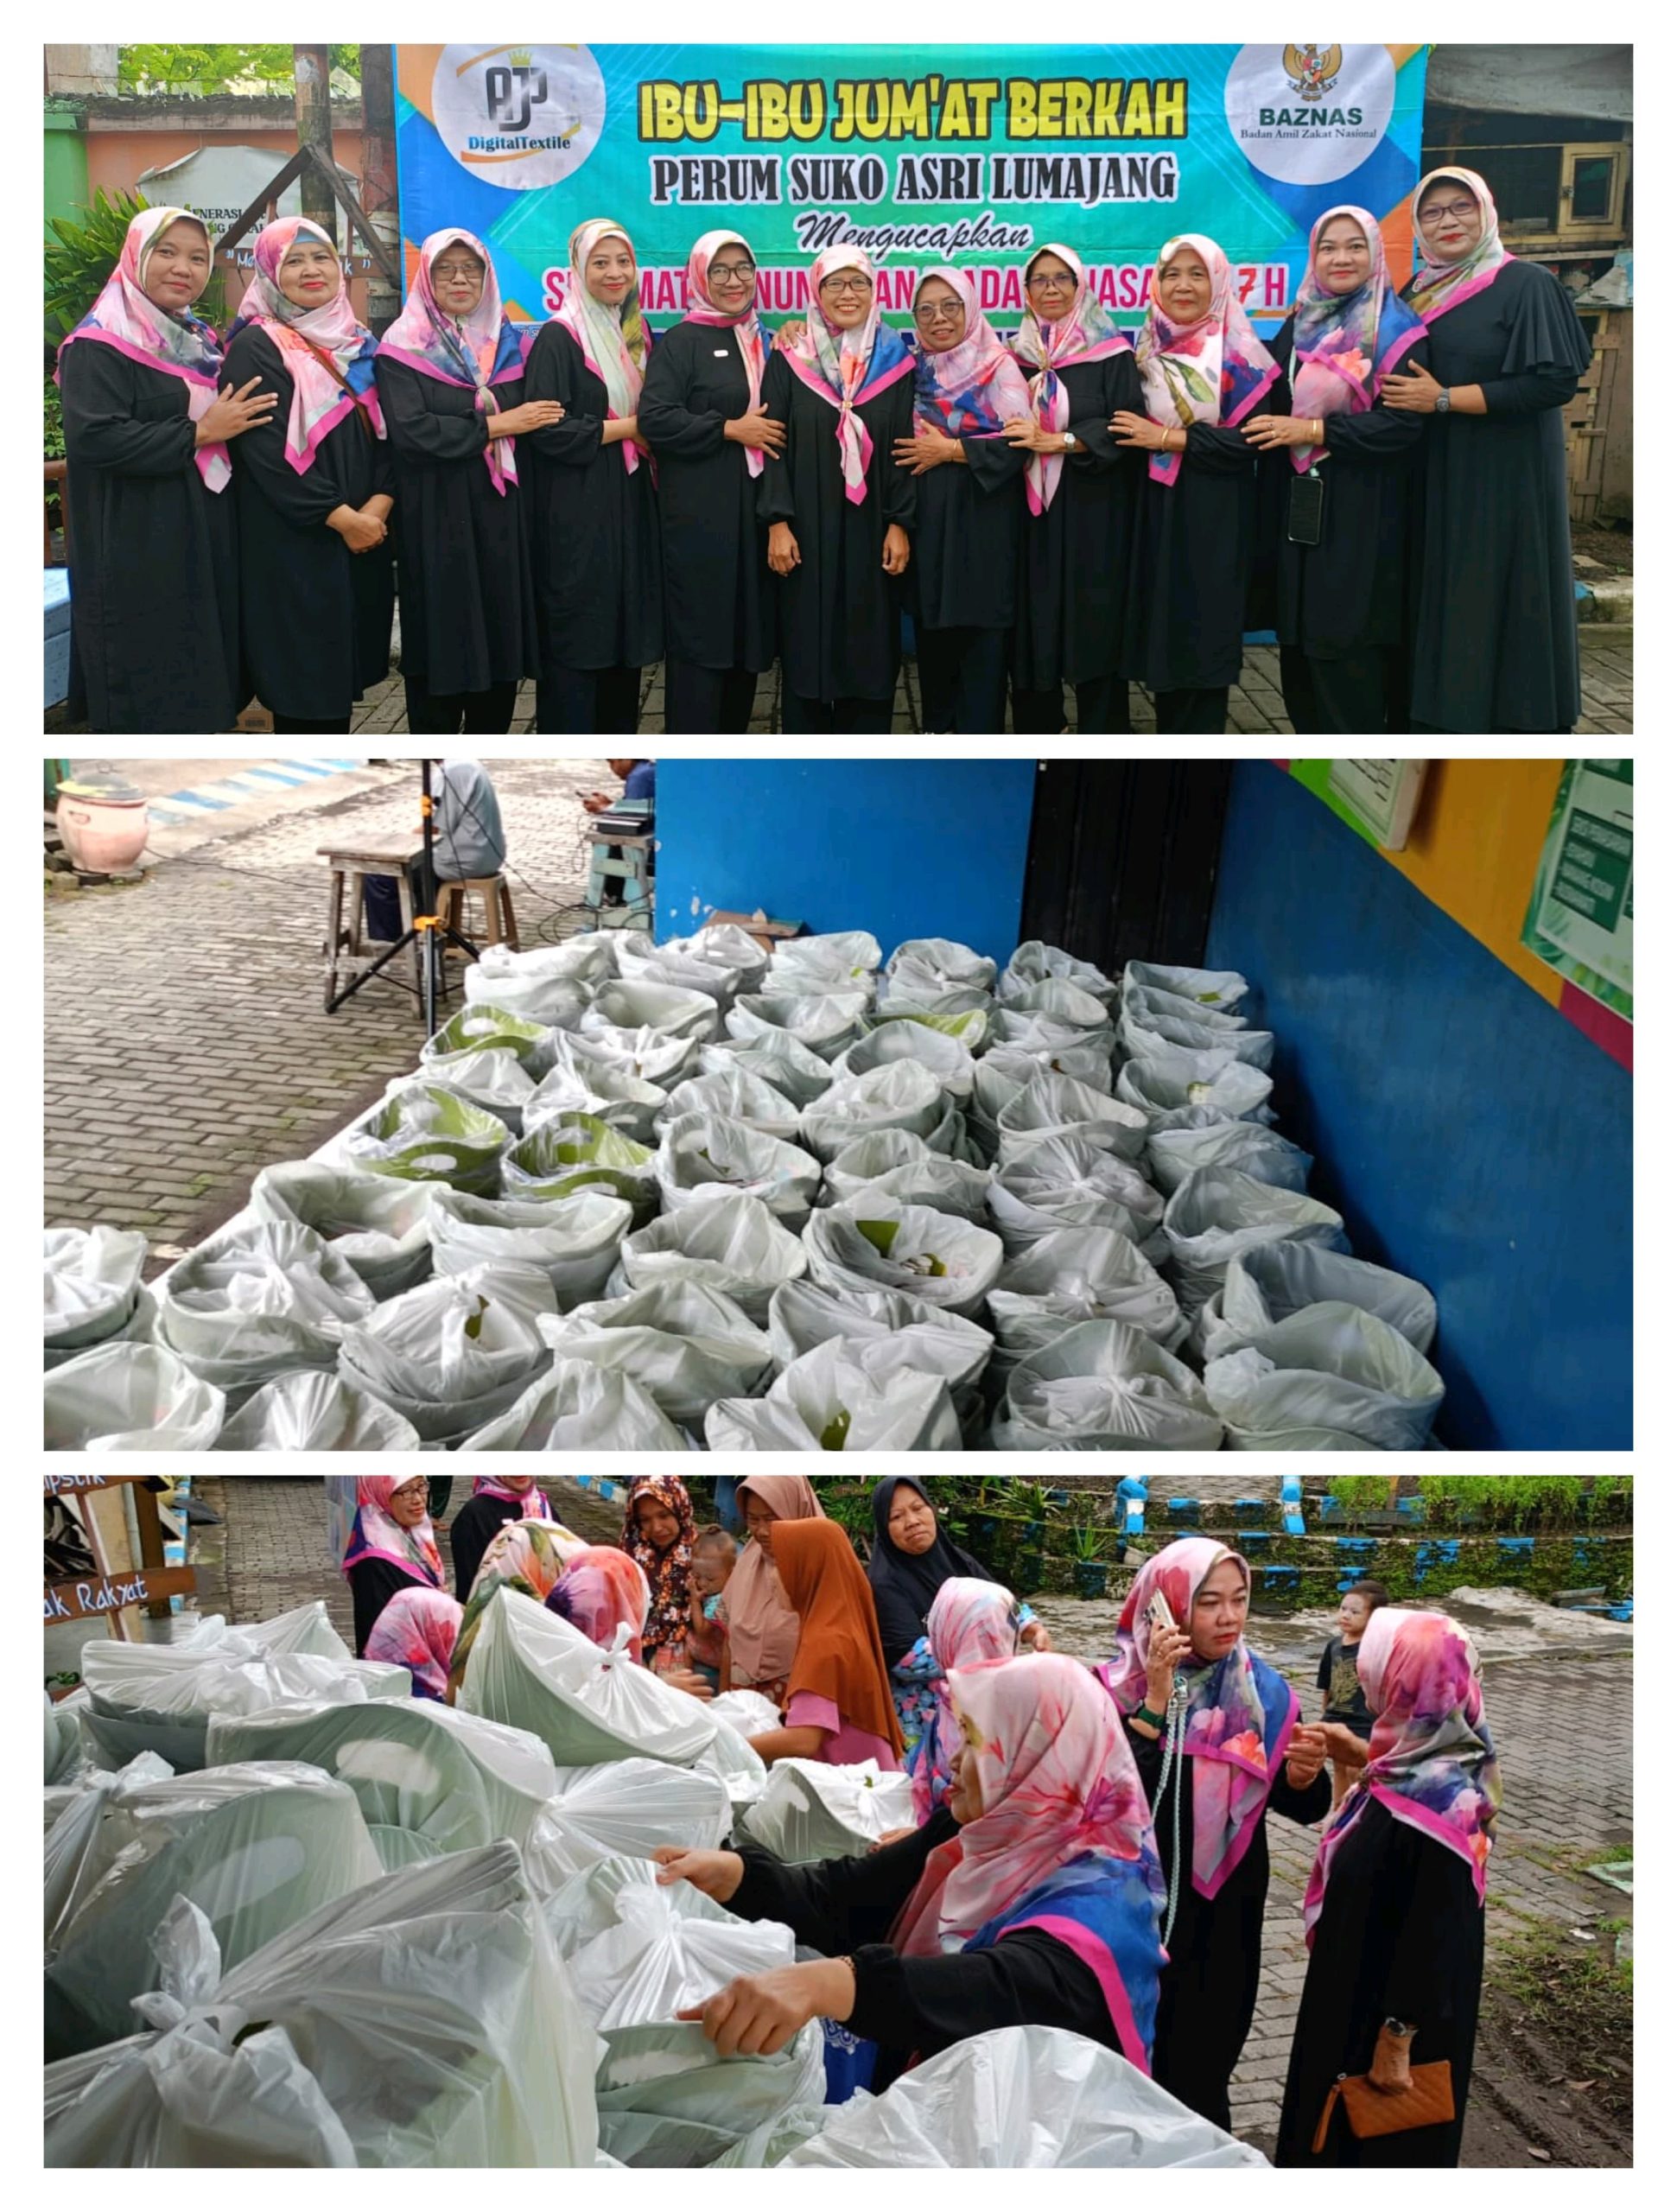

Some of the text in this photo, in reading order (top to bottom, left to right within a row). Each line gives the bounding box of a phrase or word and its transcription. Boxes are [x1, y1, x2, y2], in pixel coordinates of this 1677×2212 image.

[638, 73, 1188, 143] IBU-IBU JUM'AT BERKAH
[1259, 107, 1363, 127] BAZNAS
[467, 135, 572, 152] DigitalTextile
[1240, 128, 1378, 139] Badan Amil Zakat Nasional
[653, 156, 1176, 205] PERUM SUKO ASRI LUMAJANG
[797, 214, 1030, 258] Mengucapkan
[1265, 268, 1285, 307] H
[76, 1573, 149, 1611] Rakyat
